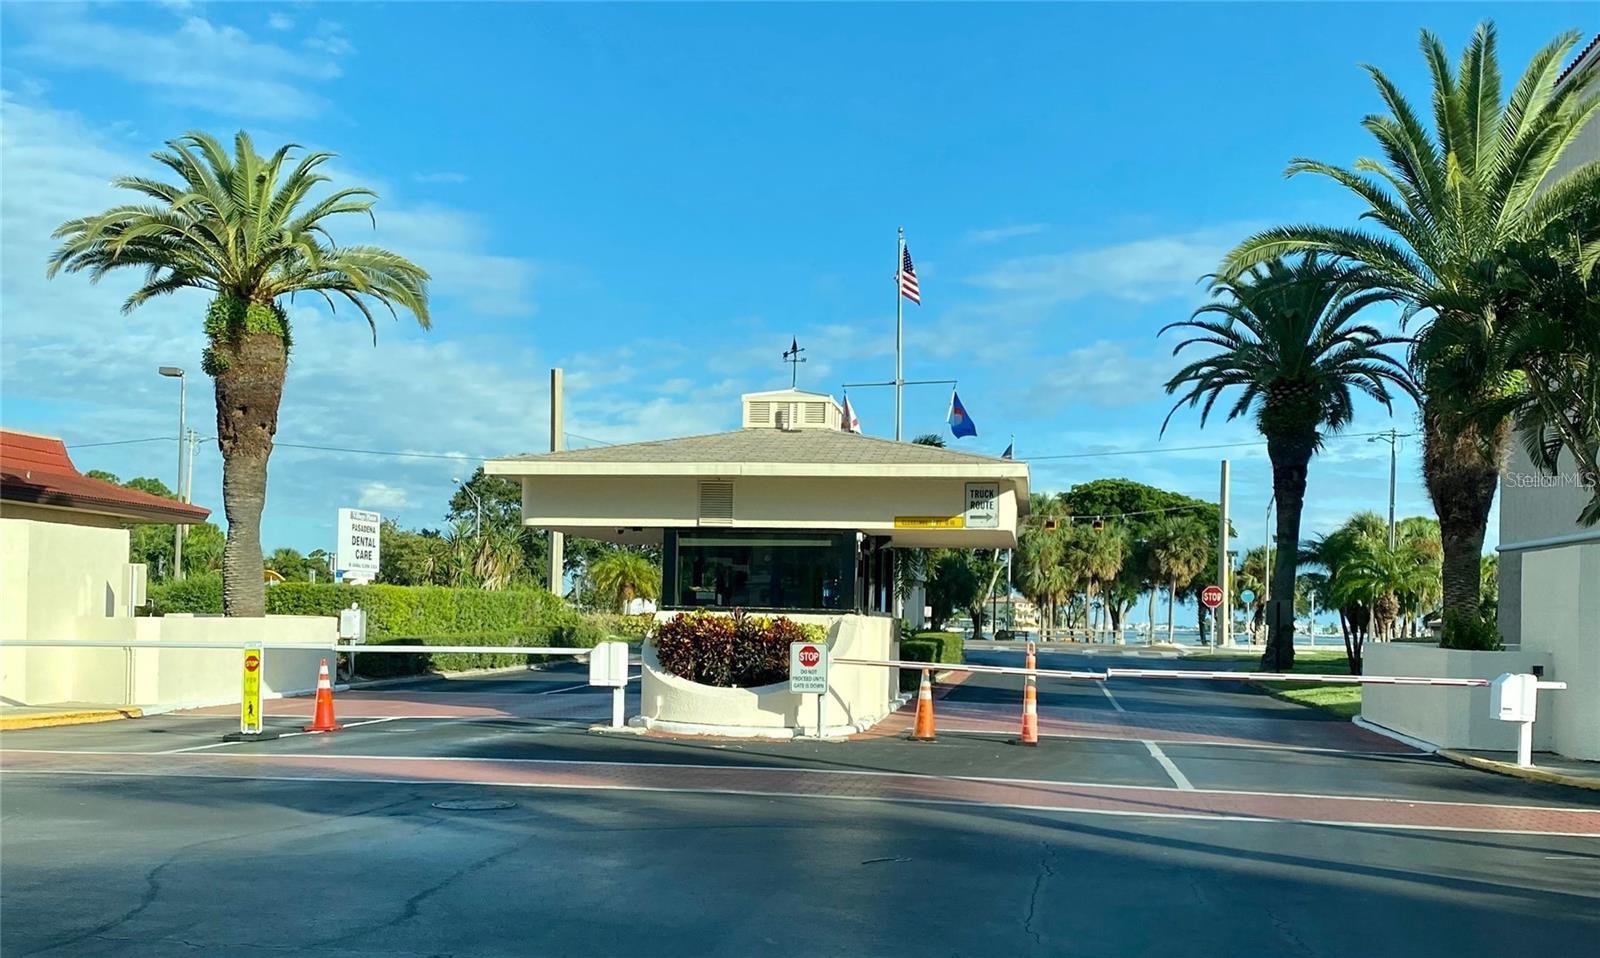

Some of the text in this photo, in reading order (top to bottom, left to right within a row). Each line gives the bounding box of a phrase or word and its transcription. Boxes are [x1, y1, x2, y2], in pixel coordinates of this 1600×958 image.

[970, 489, 994, 498] TRUCK
[970, 501, 994, 510] ROUTE
[352, 523, 376, 534] PASADENA
[351, 535, 376, 548] DENTAL
[355, 549, 373, 561] CARE
[1204, 592, 1222, 601] STOP
[799, 651, 819, 661] STOP
